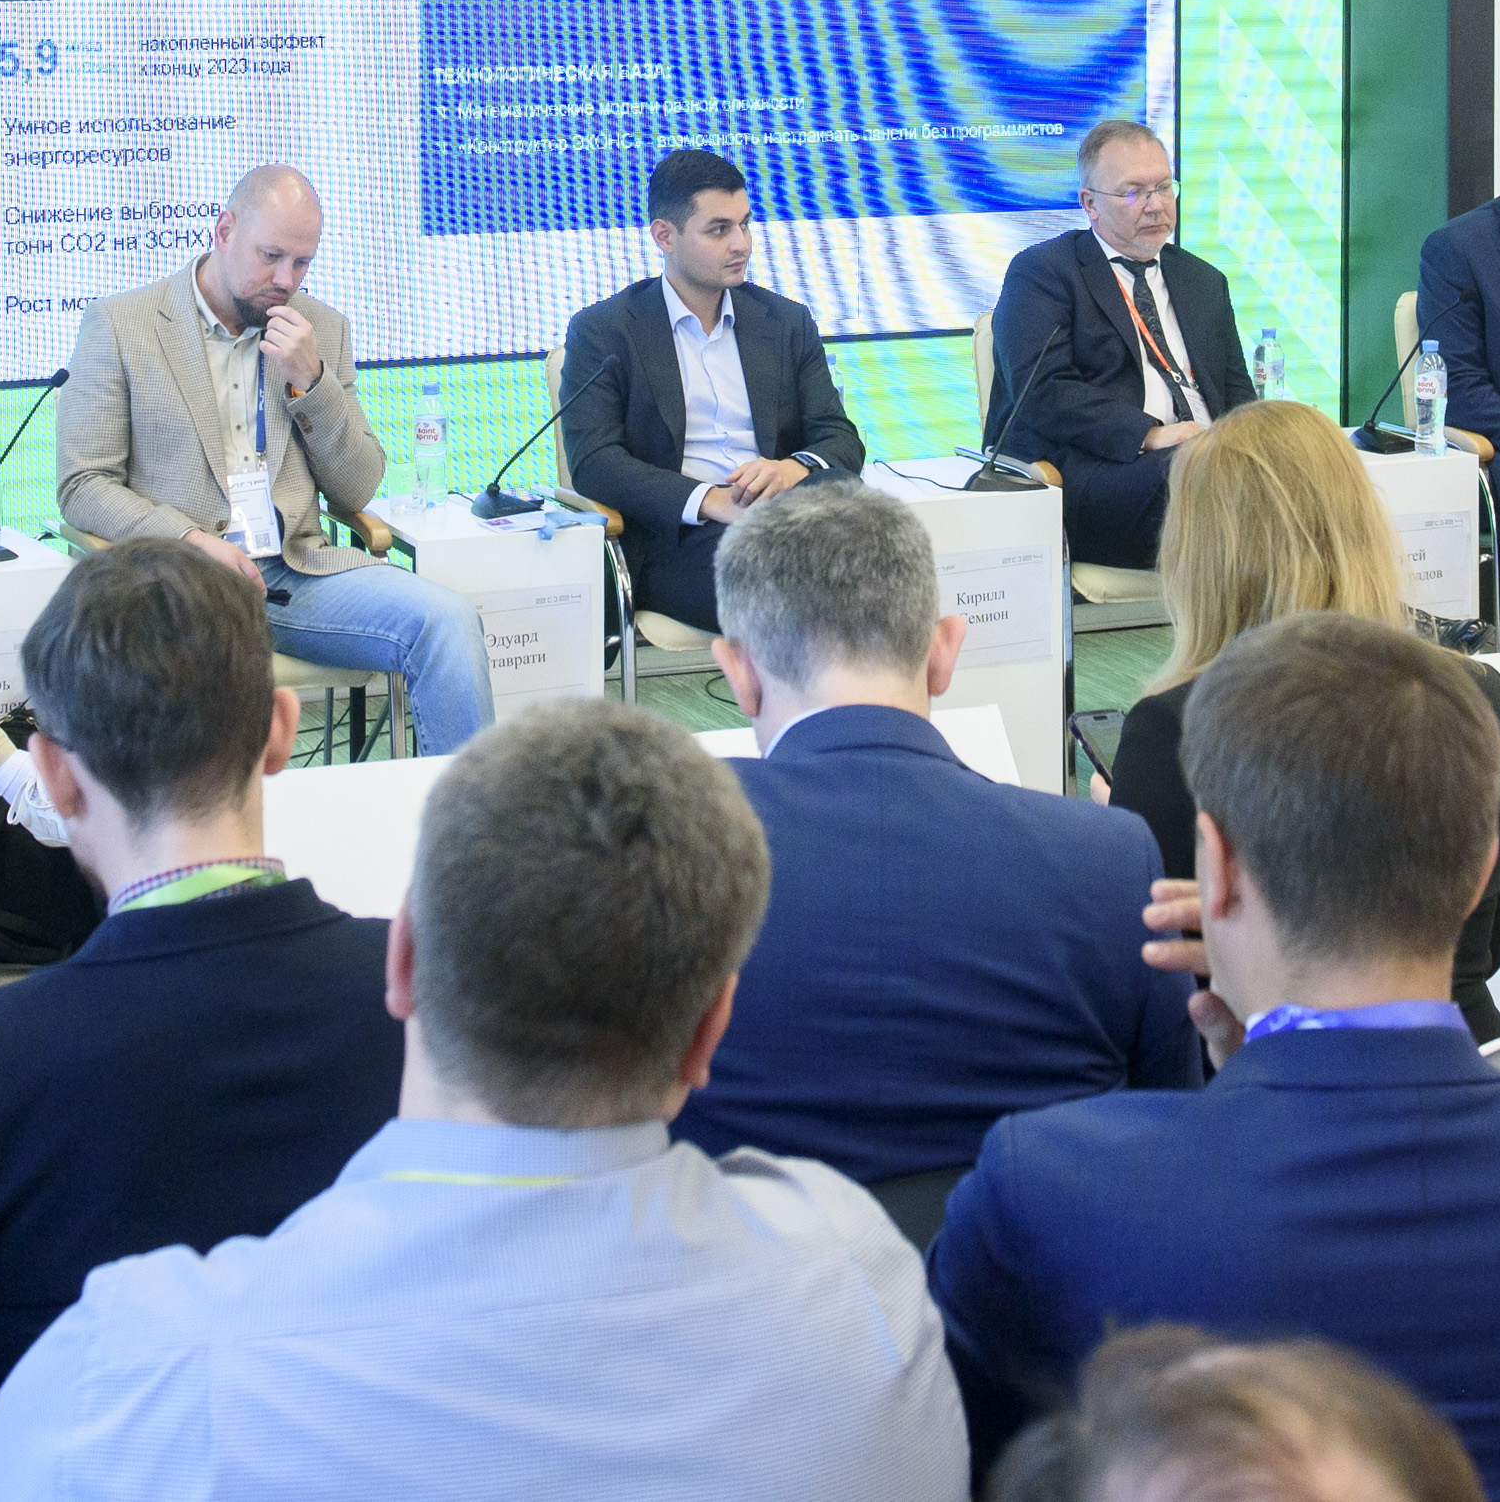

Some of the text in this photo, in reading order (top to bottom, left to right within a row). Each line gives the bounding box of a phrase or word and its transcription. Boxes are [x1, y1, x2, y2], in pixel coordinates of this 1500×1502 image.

[139, 33, 327, 54] накопленный эффект
[153, 61, 202, 78] концу
[3, 114, 237, 136] Умное использование
[921, 122, 947, 140] без
[951, 121, 1065, 141] программистов
[3, 146, 172, 169] энергоресурсов
[4, 205, 114, 226] Снижение
[4, 239, 53, 256] тонн
[113, 237, 138, 251] на
[5, 295, 53, 315] Рост
[956, 589, 1006, 607] Кирилл
[485, 631, 539, 650] Эдуард
[488, 652, 547, 670] таврати
